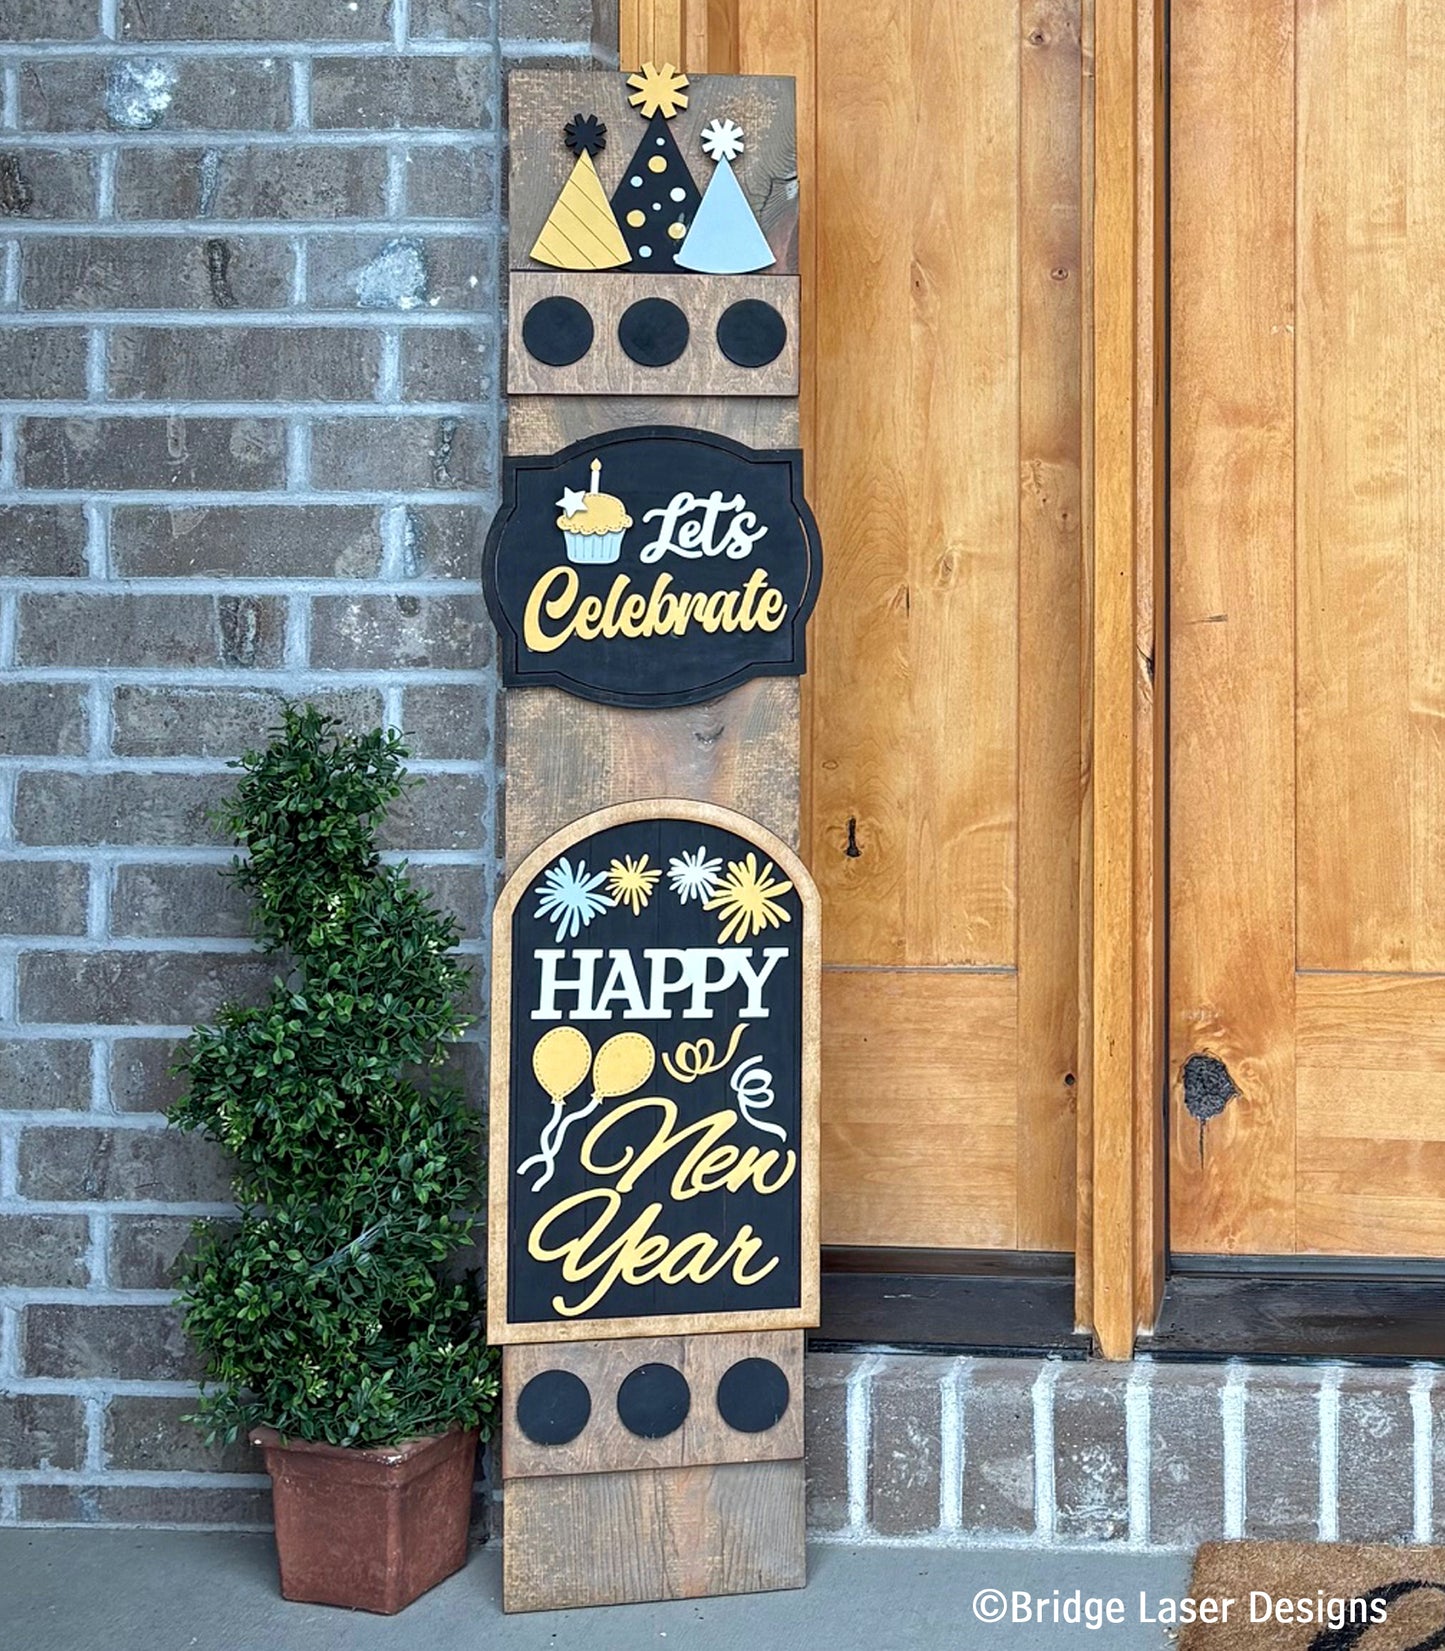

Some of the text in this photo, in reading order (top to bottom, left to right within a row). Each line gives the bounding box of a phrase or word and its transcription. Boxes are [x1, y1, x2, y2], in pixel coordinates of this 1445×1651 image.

[639, 490, 768, 564] Let's
[523, 565, 788, 653] Celebrate
[530, 947, 789, 1020] HAPPY
[580, 1096, 796, 1201] New
[527, 1187, 779, 1317] Year
